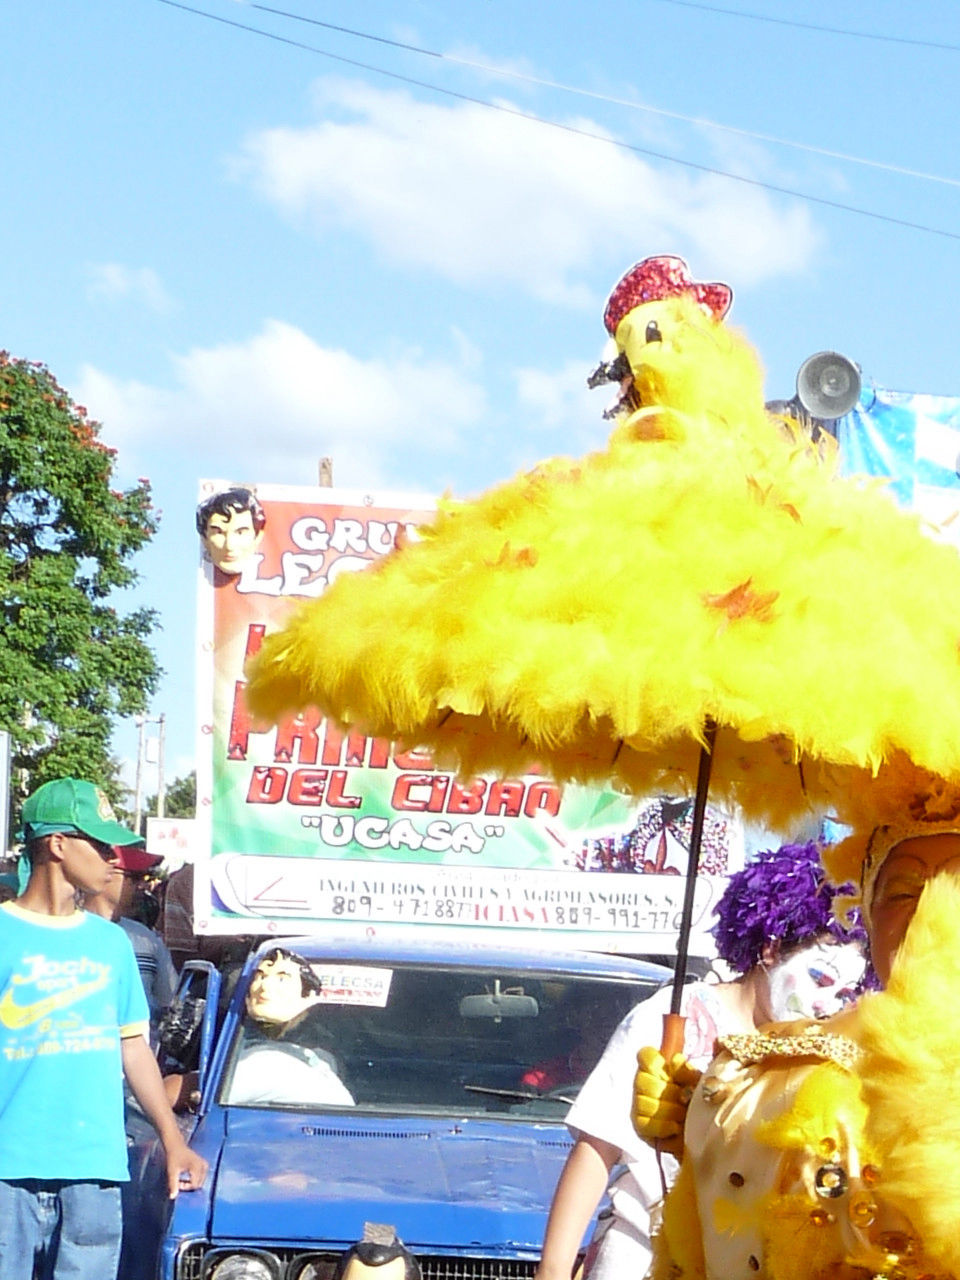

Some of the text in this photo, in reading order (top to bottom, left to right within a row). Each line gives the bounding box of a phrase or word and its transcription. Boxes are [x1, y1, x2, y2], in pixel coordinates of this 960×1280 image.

[246, 765, 560, 818] DEL CIBAO
[300, 814, 505, 853] "UCASA"
